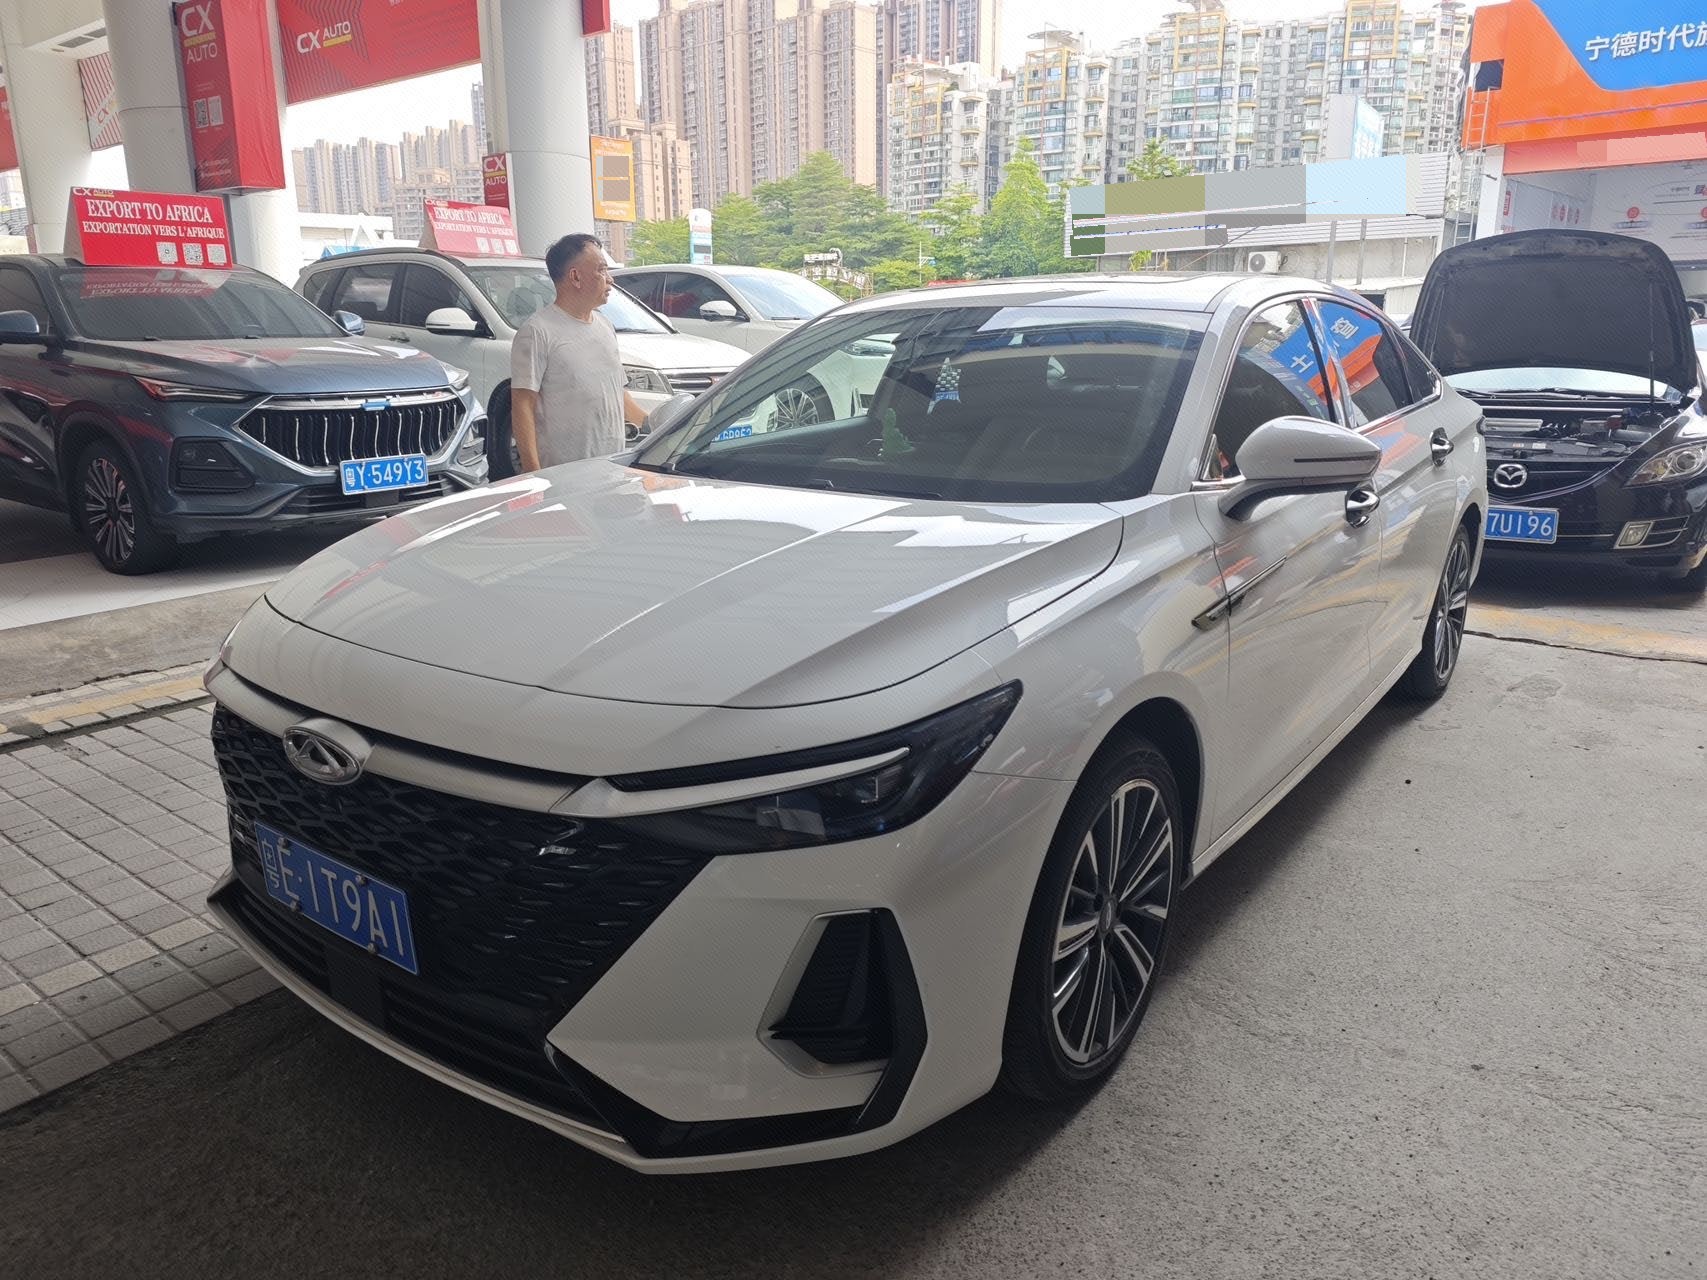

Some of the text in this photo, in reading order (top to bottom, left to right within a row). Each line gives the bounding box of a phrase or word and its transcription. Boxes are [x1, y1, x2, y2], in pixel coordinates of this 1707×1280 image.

[181, 1, 215, 37] CX
[296, 21, 351, 54] CX AUTO
[186, 43, 218, 65] AUTO
[484, 156, 506, 173] CX
[485, 176, 507, 186] AUTO
[72, 187, 92, 196] CX
[86, 199, 213, 224] EXPORT TO AFRICA
[434, 207, 505, 226] EXPORT TO AFRICA
[82, 221, 225, 239] EXPORTATION VERS L'AFRIQUE
[1488, 513, 1552, 536] 7U196
